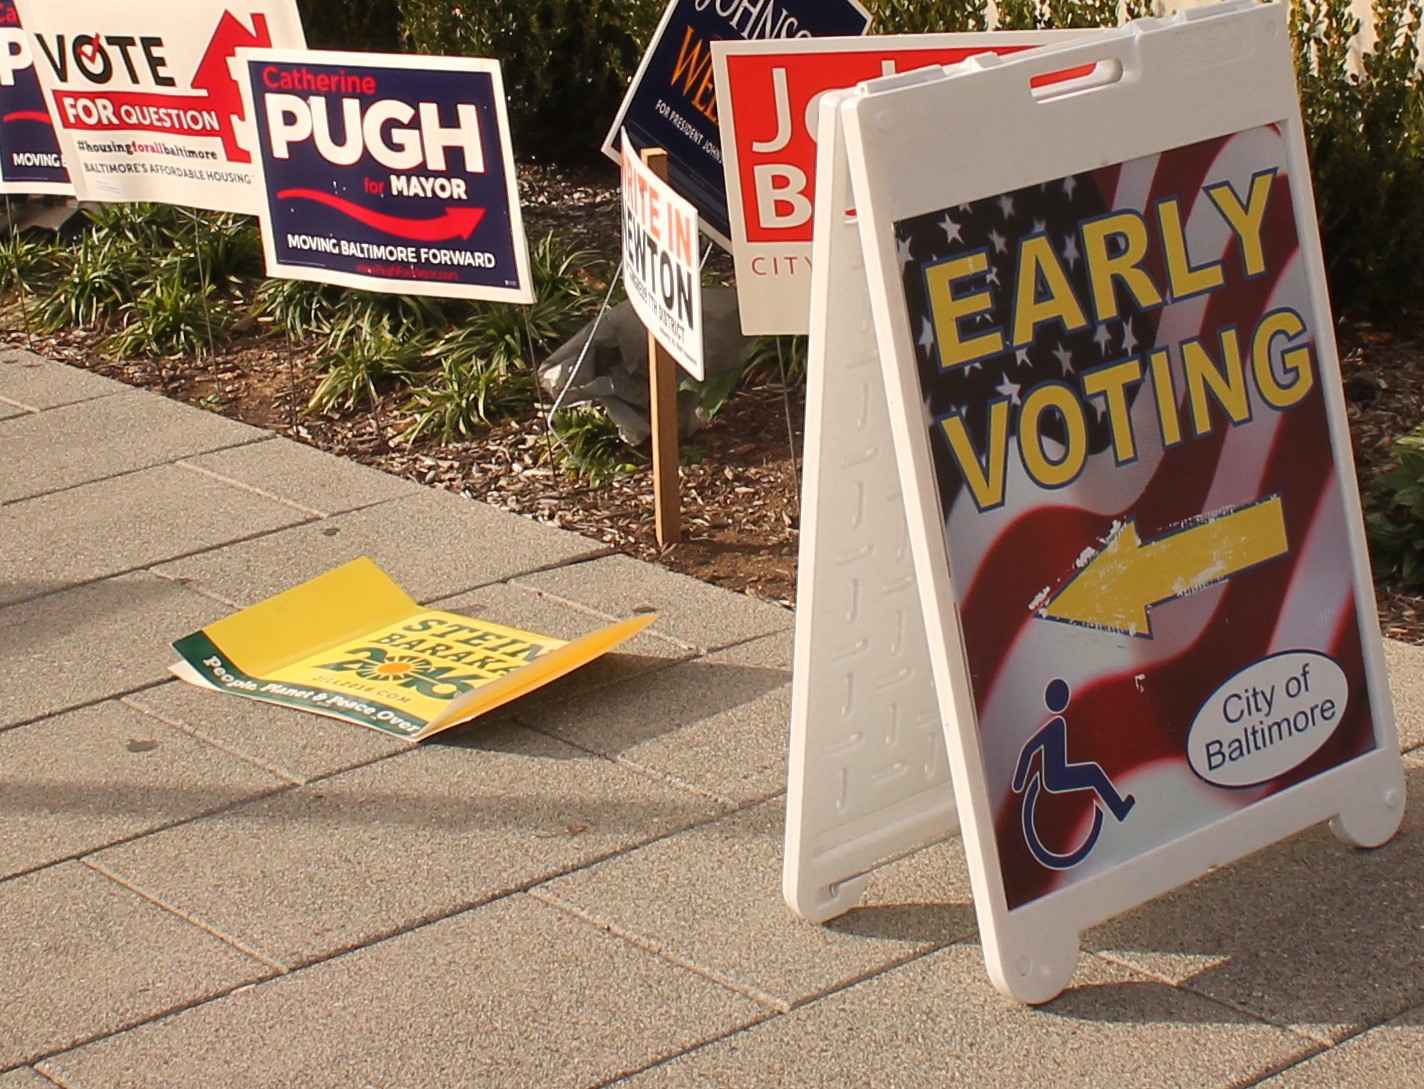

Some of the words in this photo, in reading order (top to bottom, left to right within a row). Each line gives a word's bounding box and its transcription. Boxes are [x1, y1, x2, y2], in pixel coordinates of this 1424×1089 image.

[34, 31, 178, 88] VOTE
[261, 66, 377, 95] Catherine
[62, 96, 121, 127] FOR
[120, 106, 221, 131] QUESTION
[264, 92, 486, 174] PUGH
[654, 98, 671, 119] FOR
[669, 110, 704, 146] PRESIDENT
[12, 152, 61, 168] MOVING
[76, 139, 219, 161] #housingforallbaltimore
[83, 161, 148, 175] BALTIMORE'S
[149, 164, 209, 181] AFFORDABLE
[206, 170, 252, 186] HOUSING
[363, 176, 385, 195] for
[389, 174, 468, 200] MAYOR
[286, 233, 340, 255] MOVING
[340, 235, 418, 264] BALTIMORE
[419, 247, 496, 269] FORWARD
[666, 200, 692, 268] IN
[922, 168, 1279, 372] EARLY
[940, 308, 1315, 511] VOTING
[401, 618, 547, 664] STEIN
[259, 682, 315, 703] Planet
[326, 695, 377, 718] Peace
[375, 710, 422, 736] Over
[312, 675, 412, 705] JILL2016.COM
[1222, 685, 1276, 724] City
[1284, 663, 1311, 699] of
[1204, 698, 1337, 772] Baltimore
